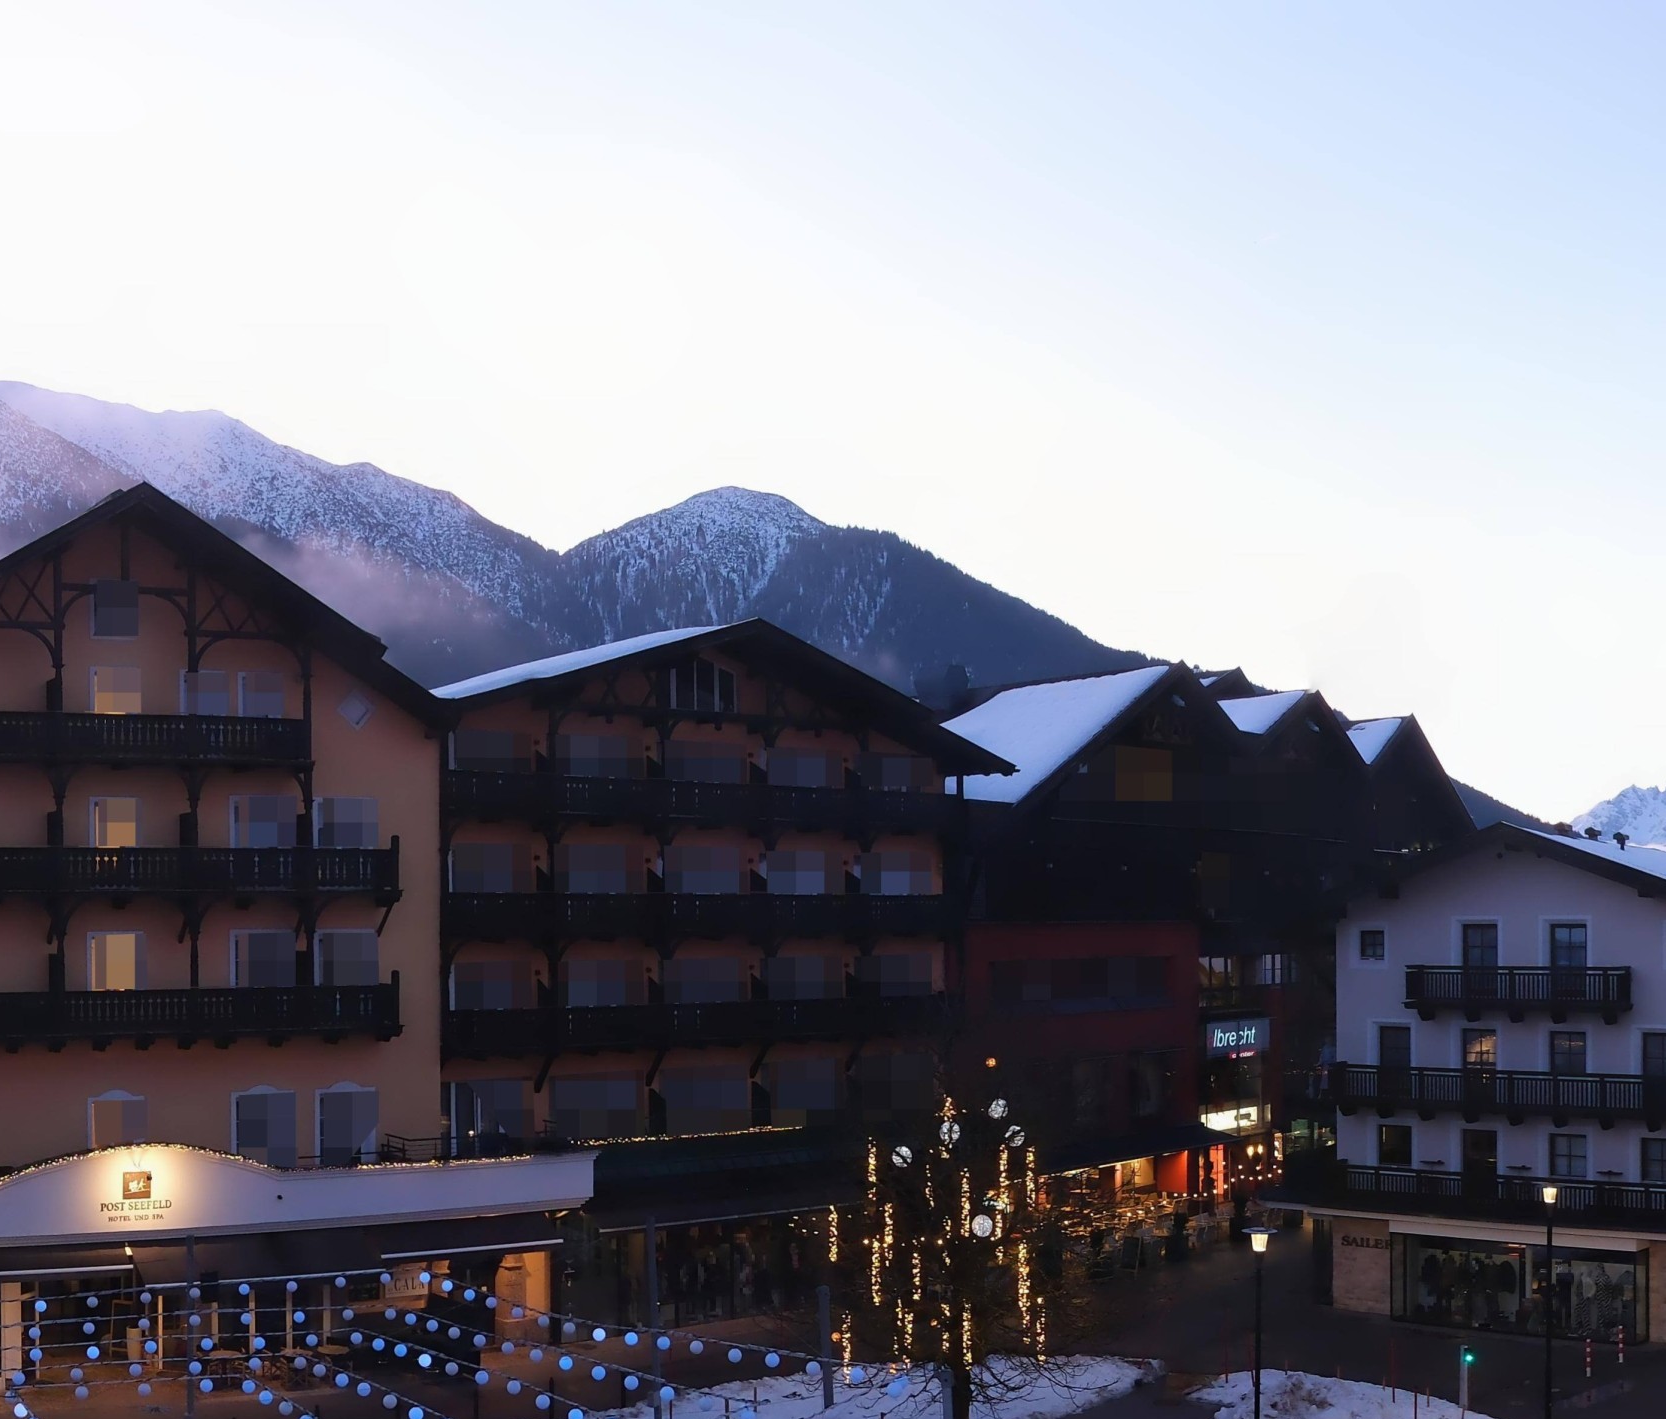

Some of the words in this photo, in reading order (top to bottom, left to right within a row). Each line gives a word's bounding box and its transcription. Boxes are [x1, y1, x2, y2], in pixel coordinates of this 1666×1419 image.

[1208, 1026, 1255, 1048] lbrecht
[100, 1202, 125, 1212] POST
[128, 1200, 172, 1211] SEEFELD
[134, 1213, 149, 1221] UND
